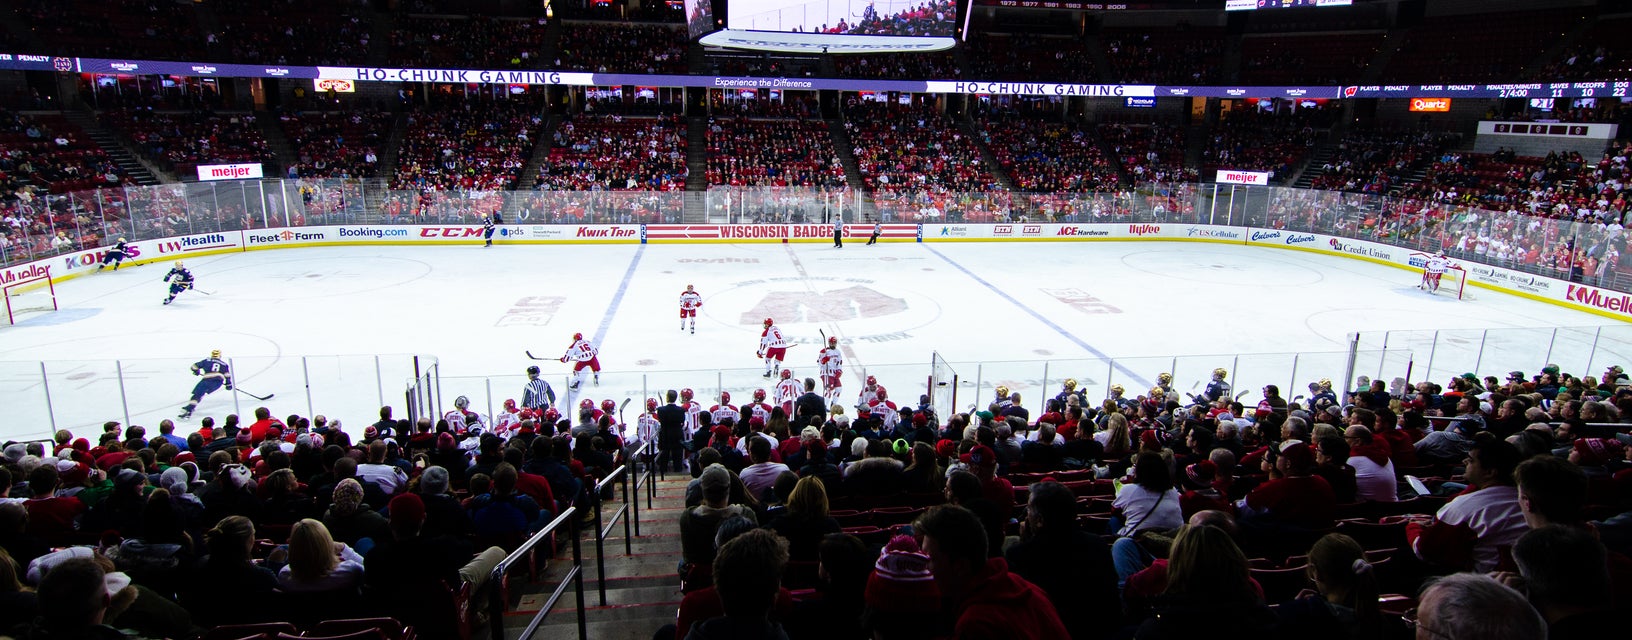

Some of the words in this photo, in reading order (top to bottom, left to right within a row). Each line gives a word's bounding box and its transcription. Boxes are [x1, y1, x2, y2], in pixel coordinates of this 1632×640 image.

[357, 68, 469, 82] HO-CHUNK
[480, 71, 561, 84] GAMING
[715, 78, 757, 87] Experience
[759, 79, 772, 87] the
[773, 79, 812, 88] Difference
[955, 82, 1046, 95] HO-CHUNK
[1054, 84, 1124, 97] GAMING
[1552, 89, 1563, 97] 11
[1581, 88, 1594, 97] 10
[1612, 88, 1626, 97] 22
[1414, 100, 1446, 110] Quartz
[211, 165, 250, 177] meijer
[1226, 172, 1258, 183] meijer
[339, 227, 407, 239] Booking.com
[420, 227, 485, 238] CCM
[509, 227, 524, 237] pds
[720, 225, 789, 238] WISCONSIN
[793, 225, 850, 238] BADGES
[1057, 226, 1078, 236] ACE
[1211, 229, 1239, 239] Cellular
[1251, 231, 1281, 242] Culver's
[249, 233, 280, 244] Fleet
[295, 231, 324, 242] Farm
[1286, 234, 1316, 245] Culver's
[65, 245, 141, 270] KOHS
[1343, 244, 1368, 256] Credit
[1369, 248, 1391, 260] Union
[773, 330, 782, 340] 6
[578, 343, 591, 353] 16
